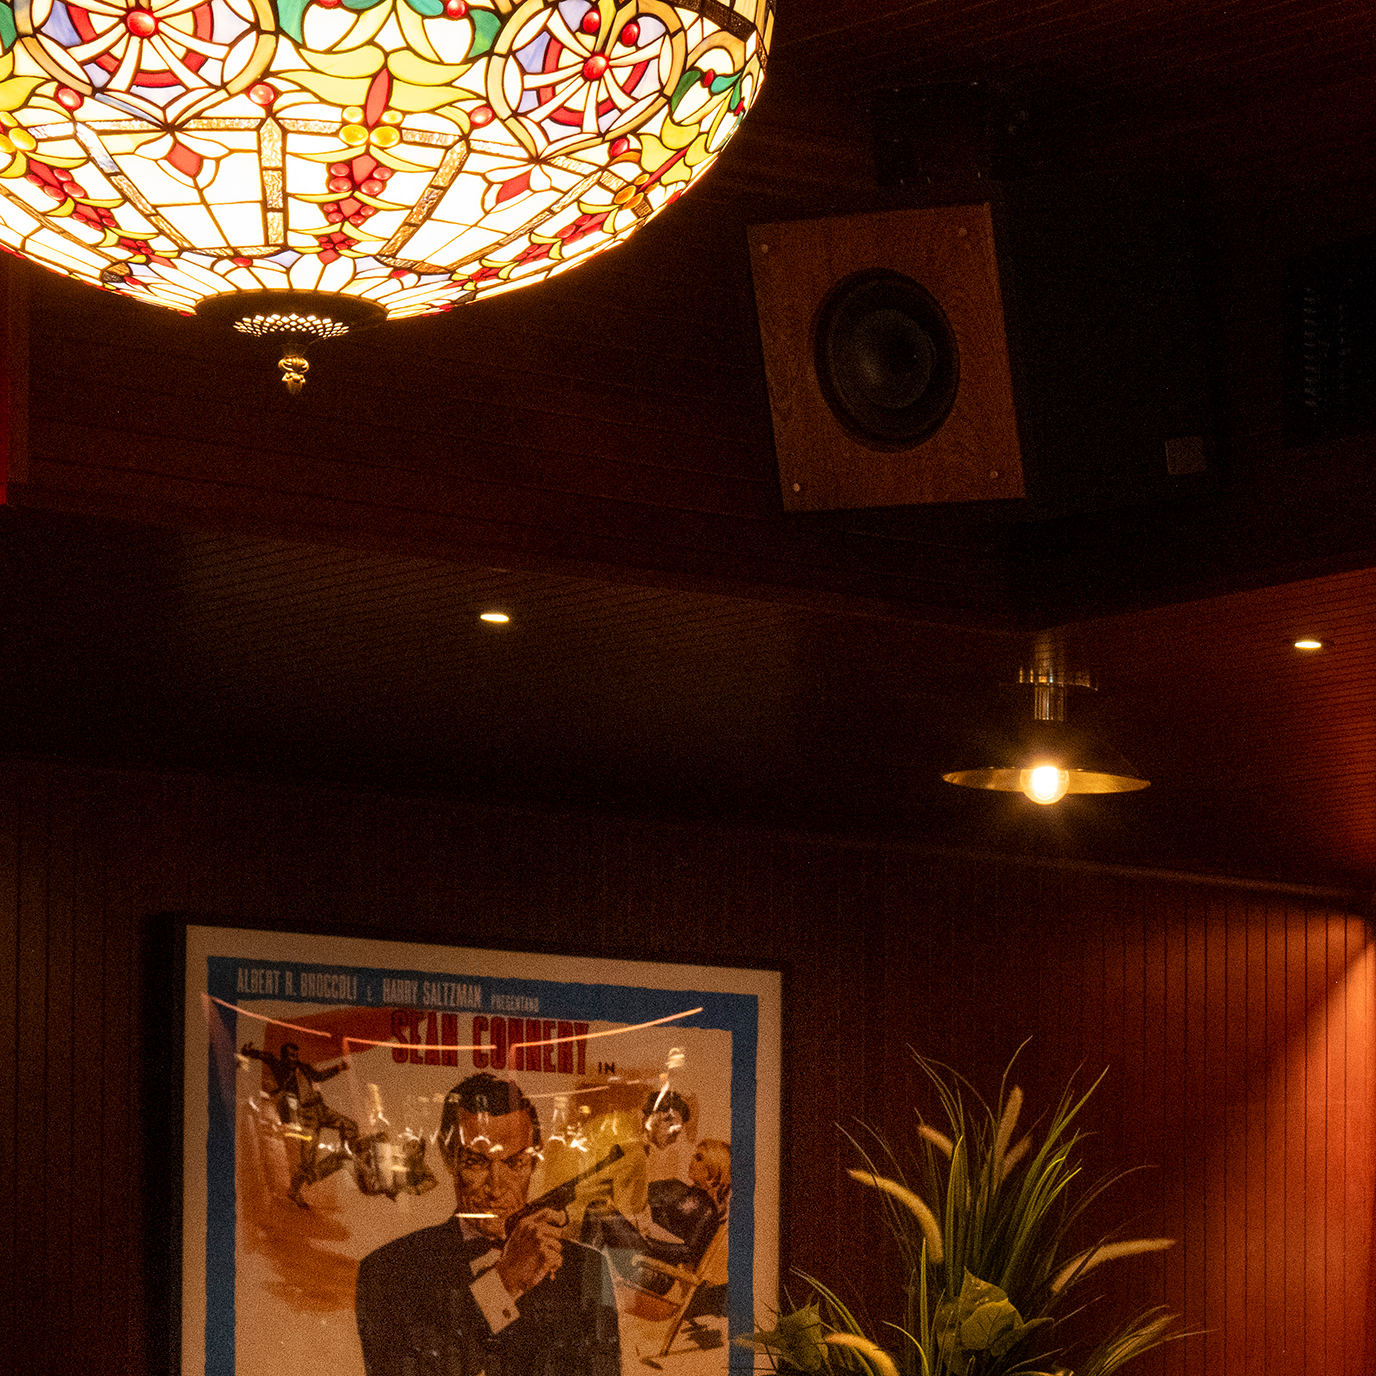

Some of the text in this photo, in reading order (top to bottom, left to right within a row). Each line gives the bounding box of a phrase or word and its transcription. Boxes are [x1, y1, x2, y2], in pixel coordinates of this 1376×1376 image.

[237, 966, 280, 995] ALBERT
[300, 973, 359, 1001] BROCCOLI
[382, 978, 418, 1005] HARRY
[423, 981, 482, 1009] SALTZMAN
[391, 1008, 590, 1075] SEAN CONNERY
[598, 1061, 616, 1075] IN
